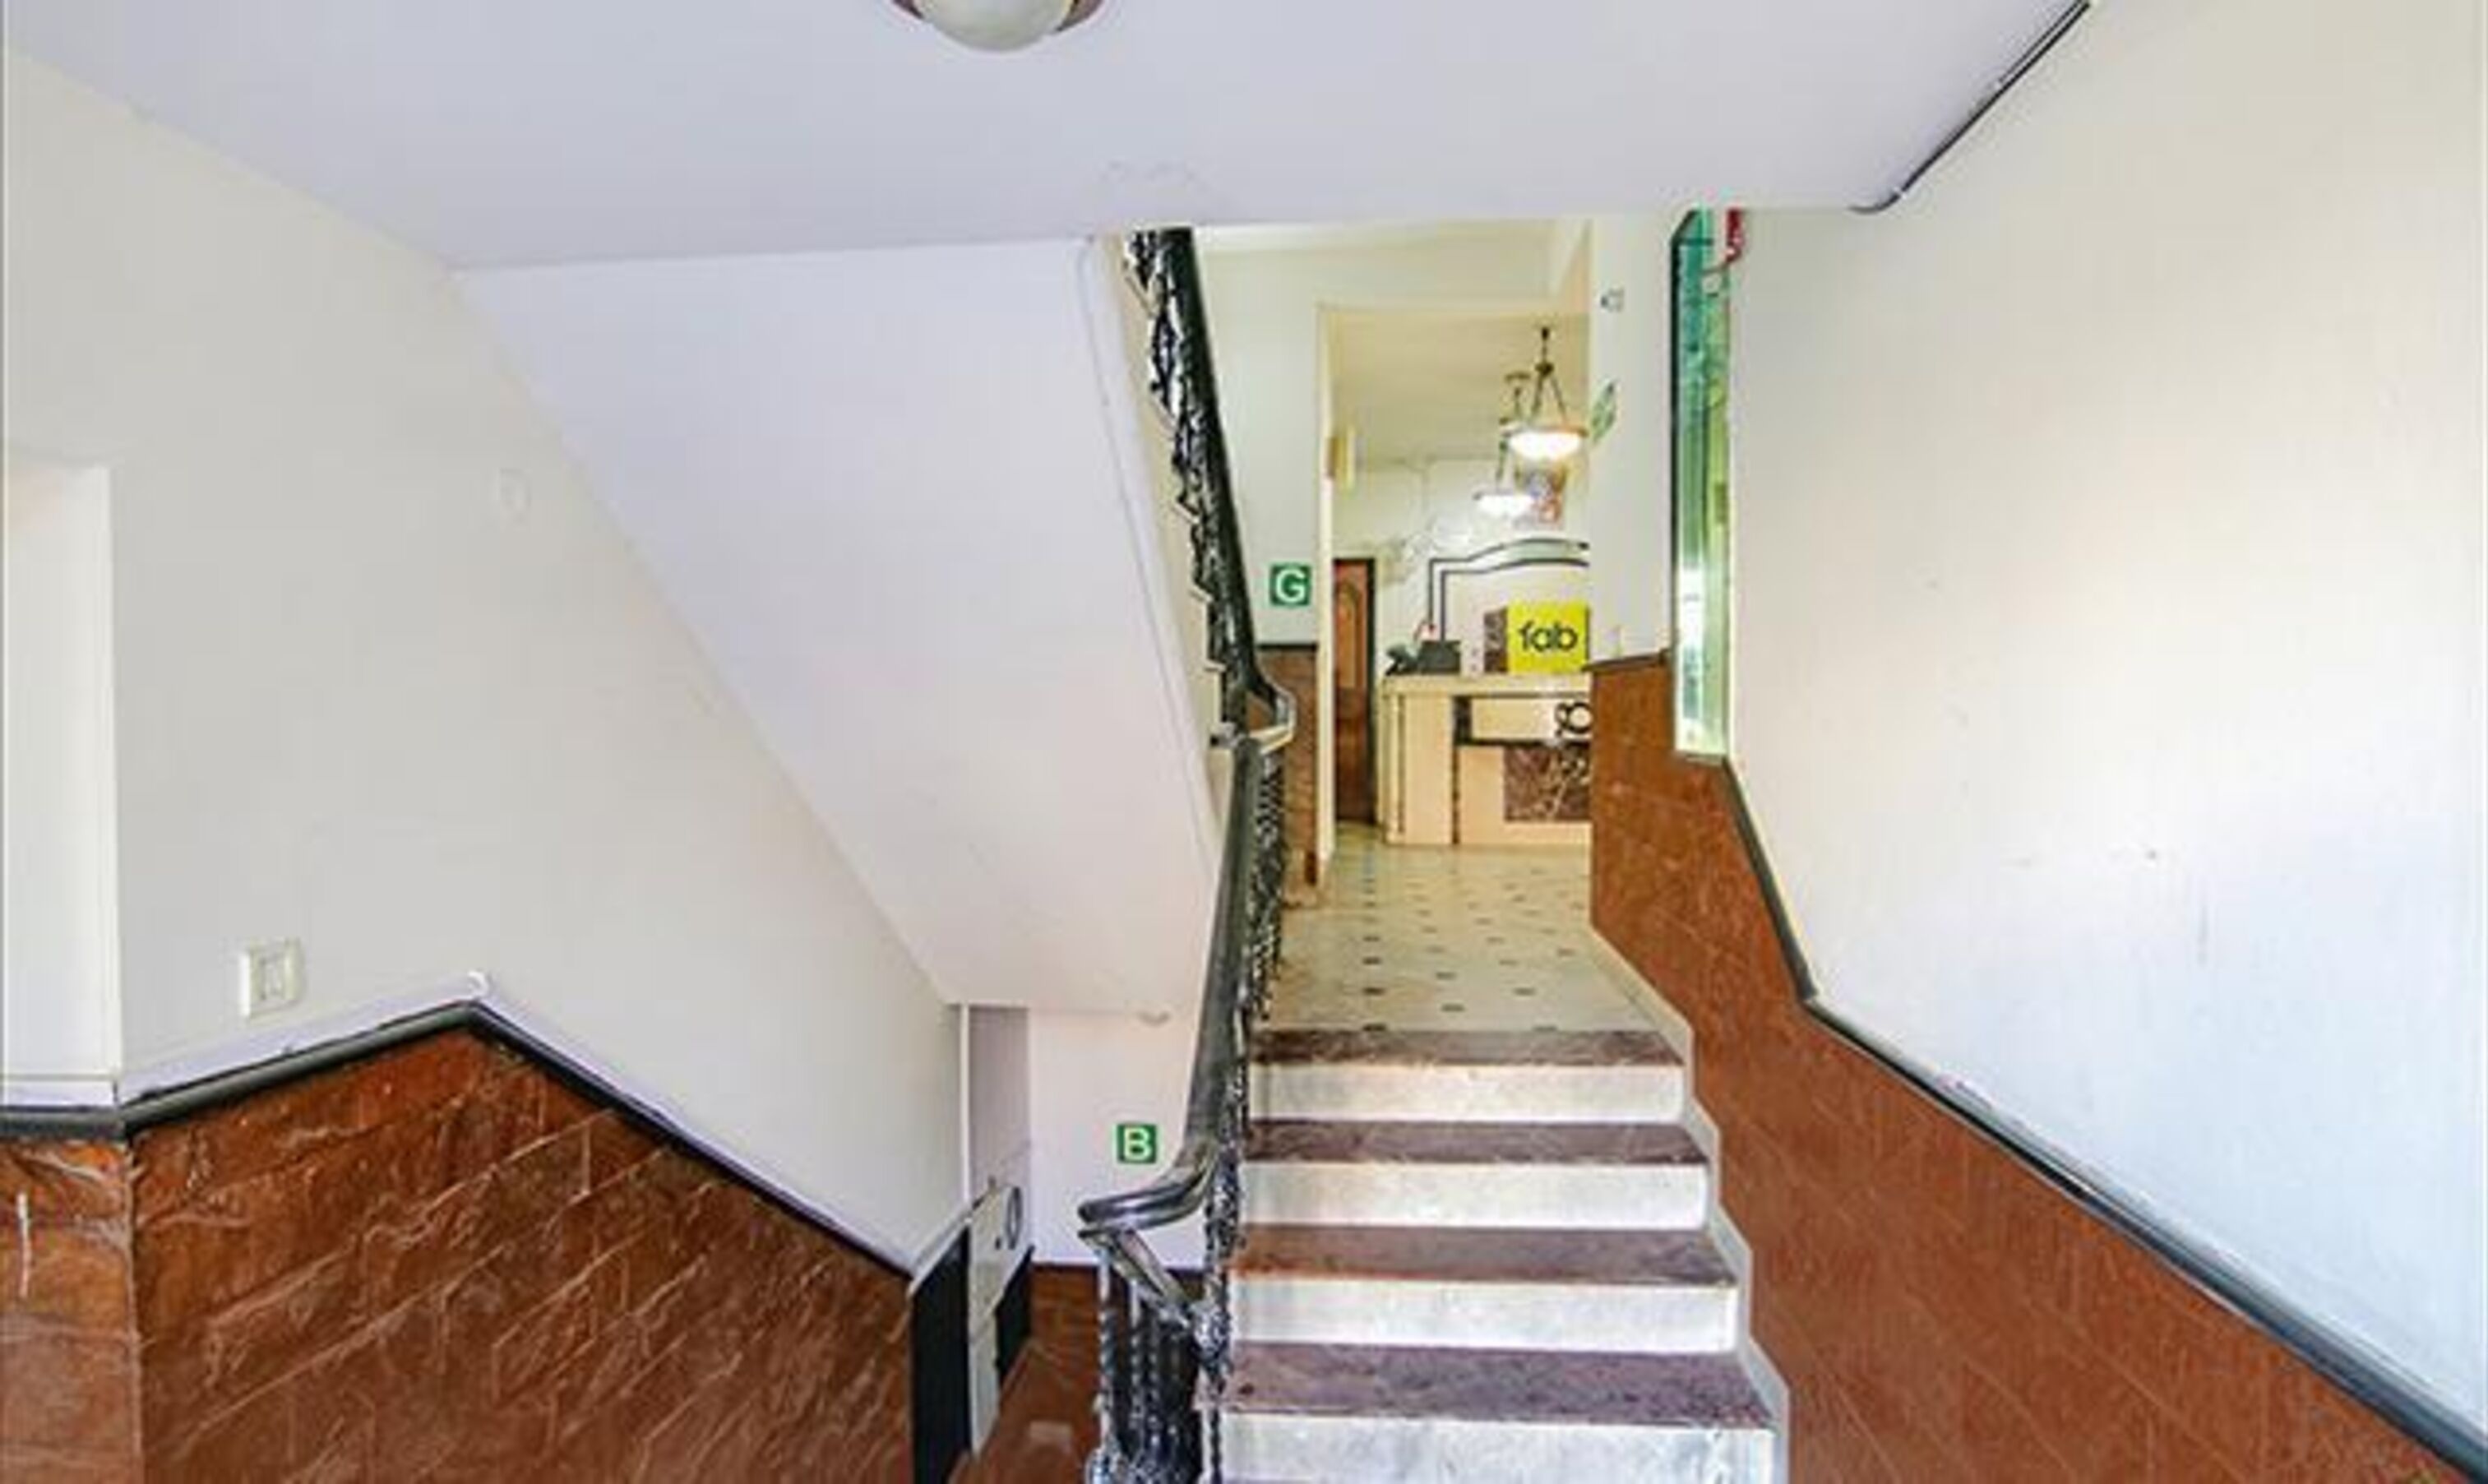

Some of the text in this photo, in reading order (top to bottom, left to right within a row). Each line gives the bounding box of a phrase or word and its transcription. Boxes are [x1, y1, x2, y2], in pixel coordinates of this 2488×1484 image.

[1275, 567, 1306, 603] G
[1519, 619, 1579, 652] fab
[1123, 1126, 1152, 1161] B
